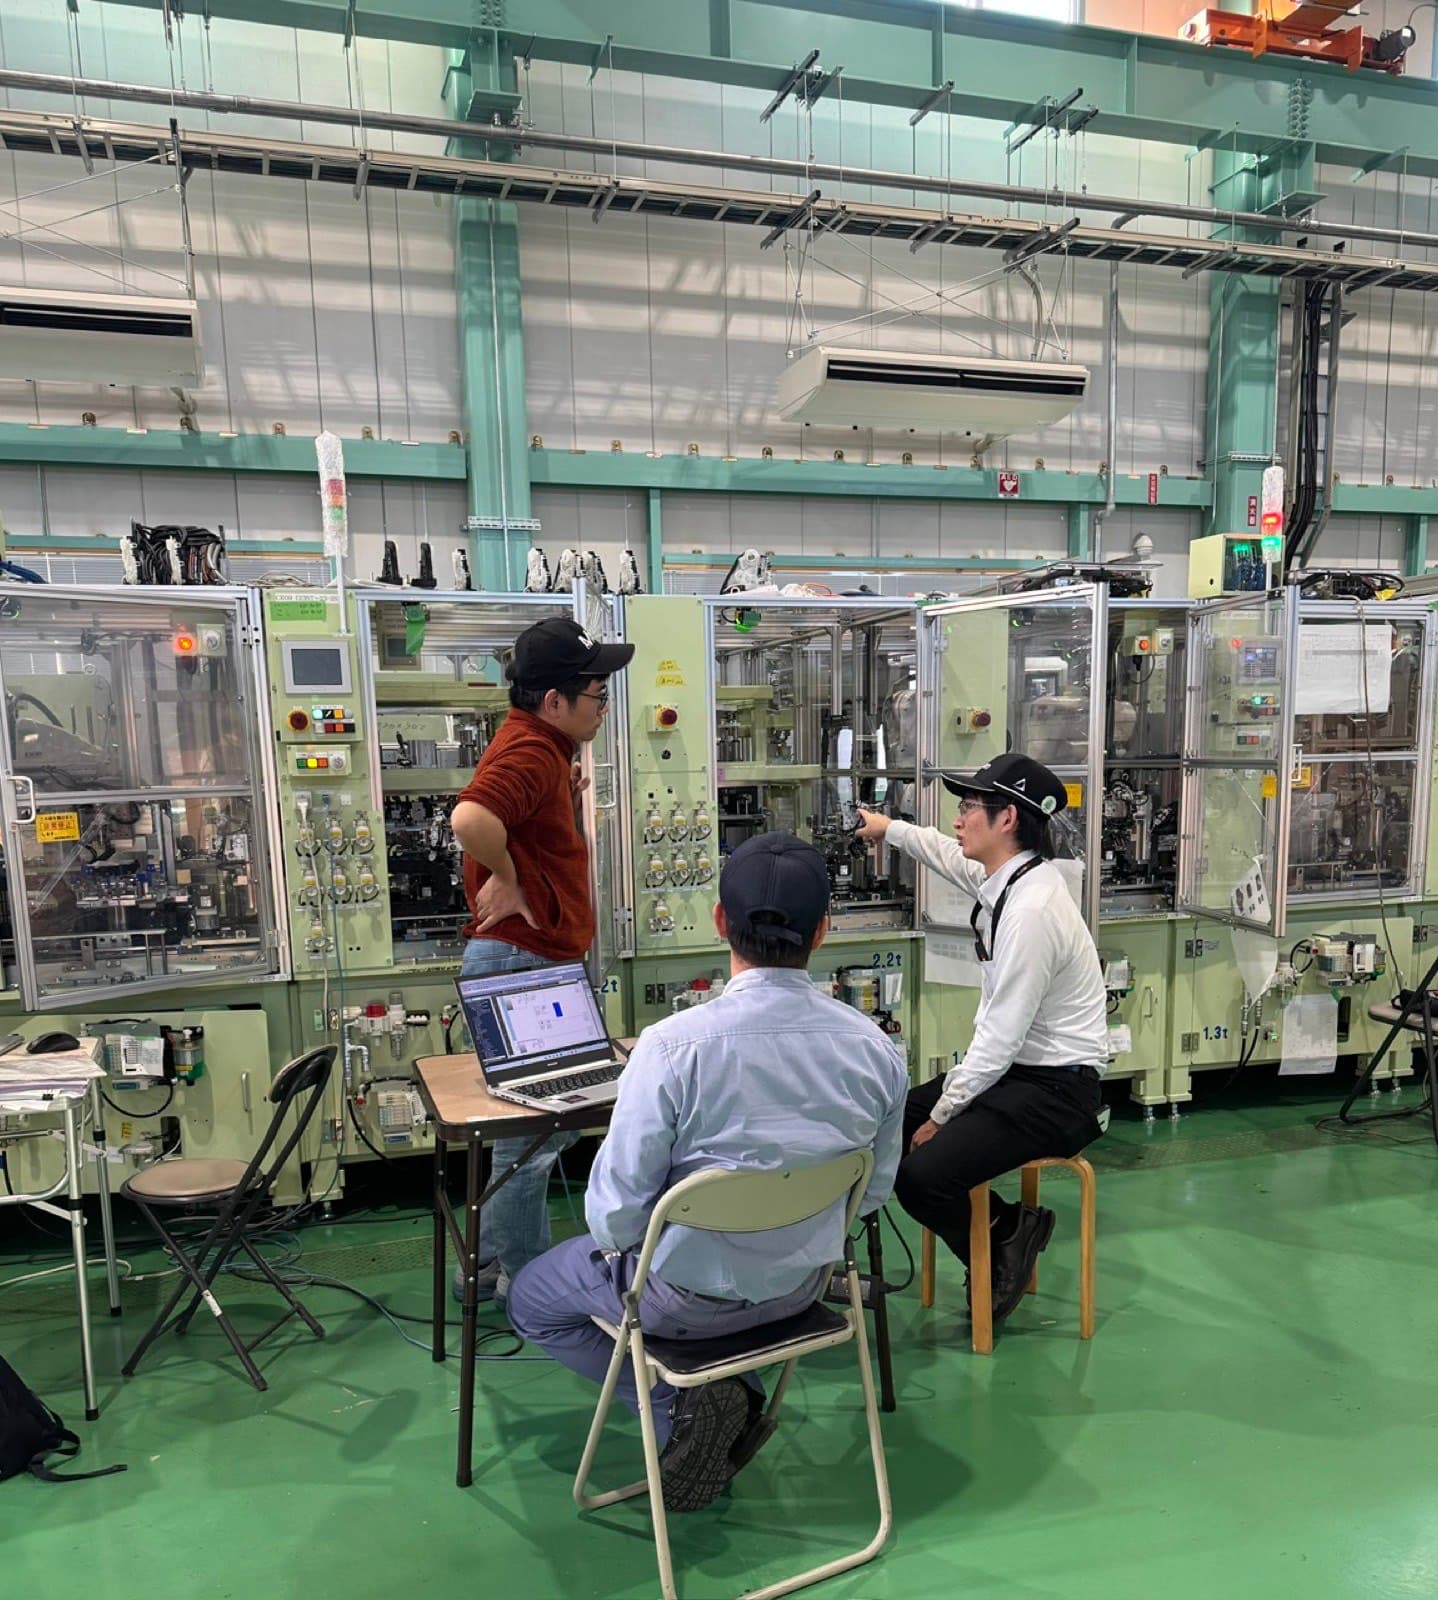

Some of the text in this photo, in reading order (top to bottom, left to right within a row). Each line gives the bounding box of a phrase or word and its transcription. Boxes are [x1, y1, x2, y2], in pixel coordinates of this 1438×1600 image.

[1000, 472, 1018, 481] AED
[873, 952, 902, 969] 2.2t
[1203, 1025, 1228, 1040] 1.3t
[952, 1050, 968, 1065] 1.
